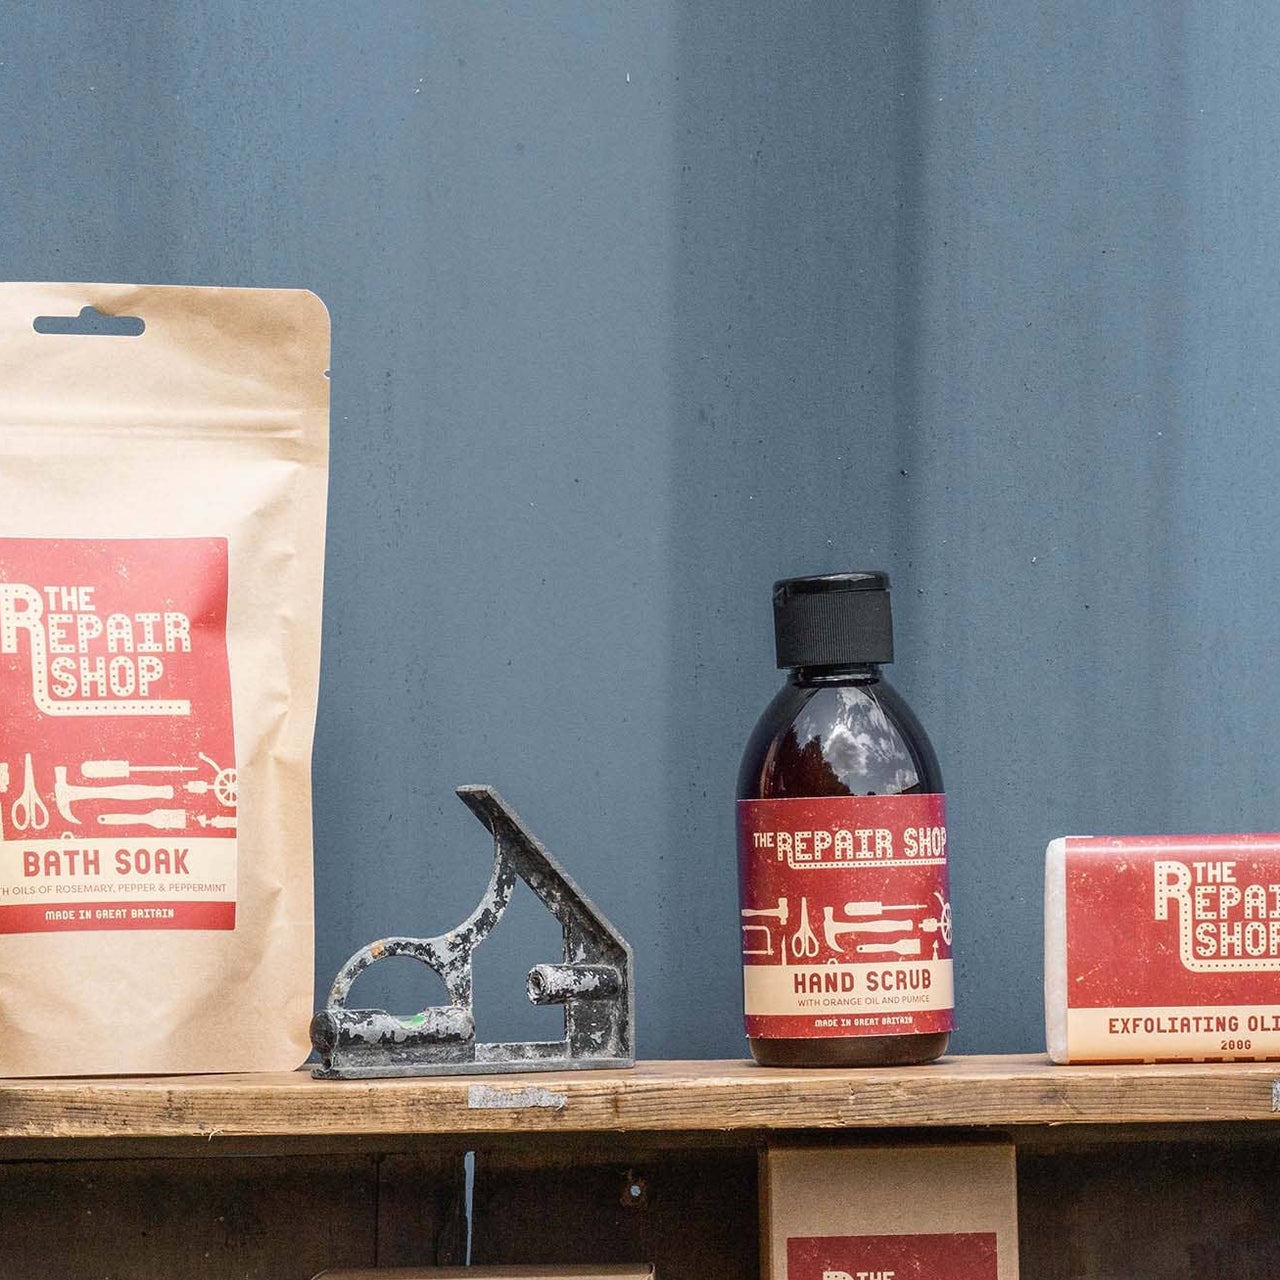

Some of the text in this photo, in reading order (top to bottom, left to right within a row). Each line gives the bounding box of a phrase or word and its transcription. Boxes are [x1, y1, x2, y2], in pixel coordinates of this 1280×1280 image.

[44, 586, 95, 611] THE
[51, 656, 163, 697] SHOP
[753, 826, 947, 861] THE REPAIR SHOP
[23, 848, 190, 877] BATH SOAK
[1193, 861, 1236, 883] THE
[12, 886, 35, 895] OILS
[38, 885, 52, 894] OF
[56, 884, 115, 894] ROSEMARY,
[118, 883, 155, 892] PEPPER
[158, 884, 166, 892] &
[169, 883, 226, 892] PEPPERMINT
[45, 908, 174, 920] MADE IN GREAT BRITAIN
[794, 969, 931, 993] HAND SCRUB
[797, 995, 929, 1007] WITH ORANGE OIL AND PUMICE
[815, 1016, 913, 1027] MADE IN GREAT BRITAIN
[1108, 1016, 1239, 1034] EXFOLIATING
